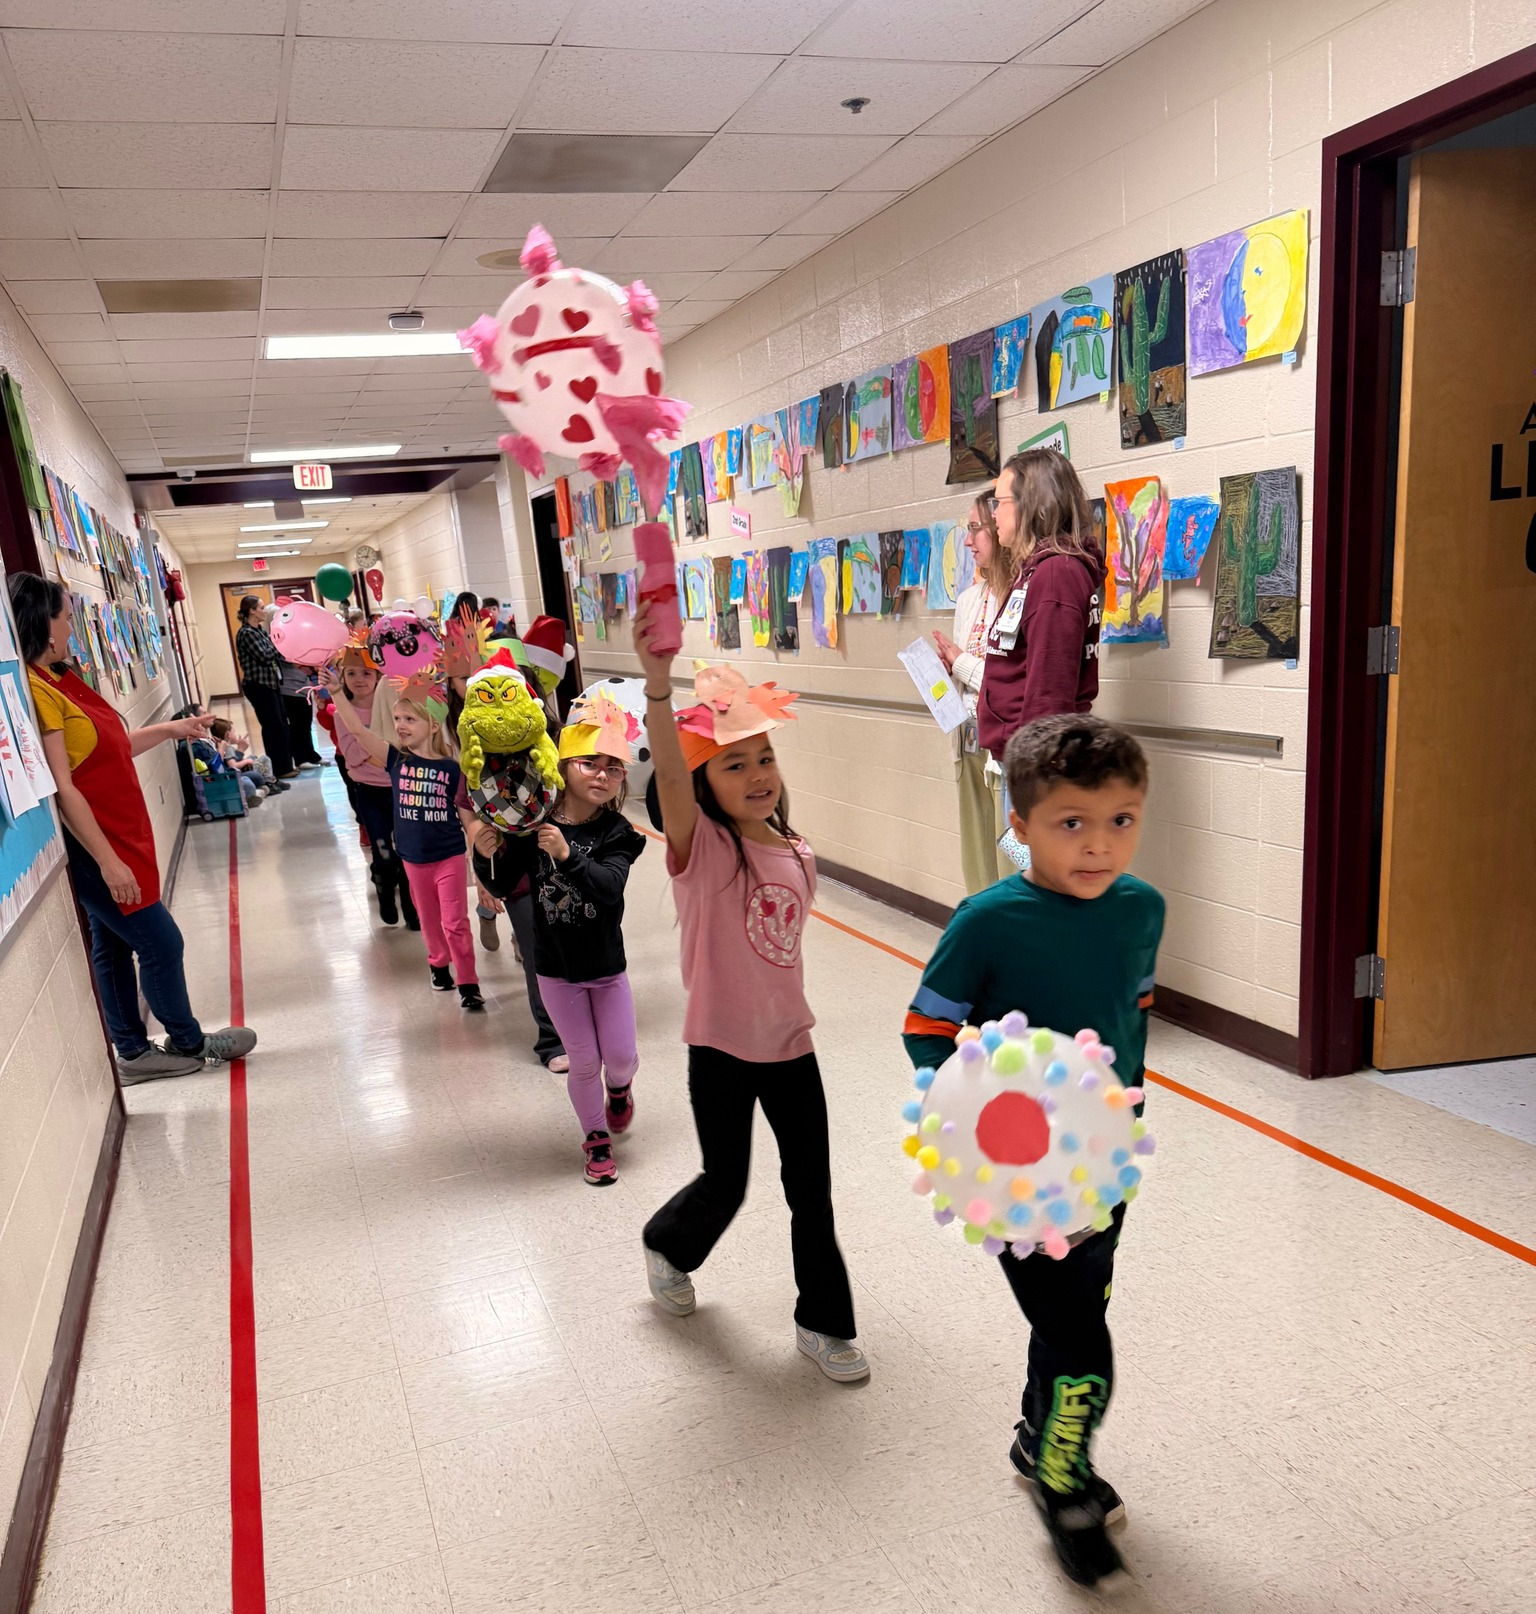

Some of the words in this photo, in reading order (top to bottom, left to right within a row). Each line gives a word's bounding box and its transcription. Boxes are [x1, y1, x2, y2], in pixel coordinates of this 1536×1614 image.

[300, 466, 325, 486] EXIT
[1490, 441, 1536, 501] L
[400, 763, 449, 784] MAGICAL
[399, 778, 447, 796] BEAUTIFUL
[399, 792, 447, 808] FABULOUS
[399, 807, 418, 820] LIKE
[424, 810, 447, 821] MOM
